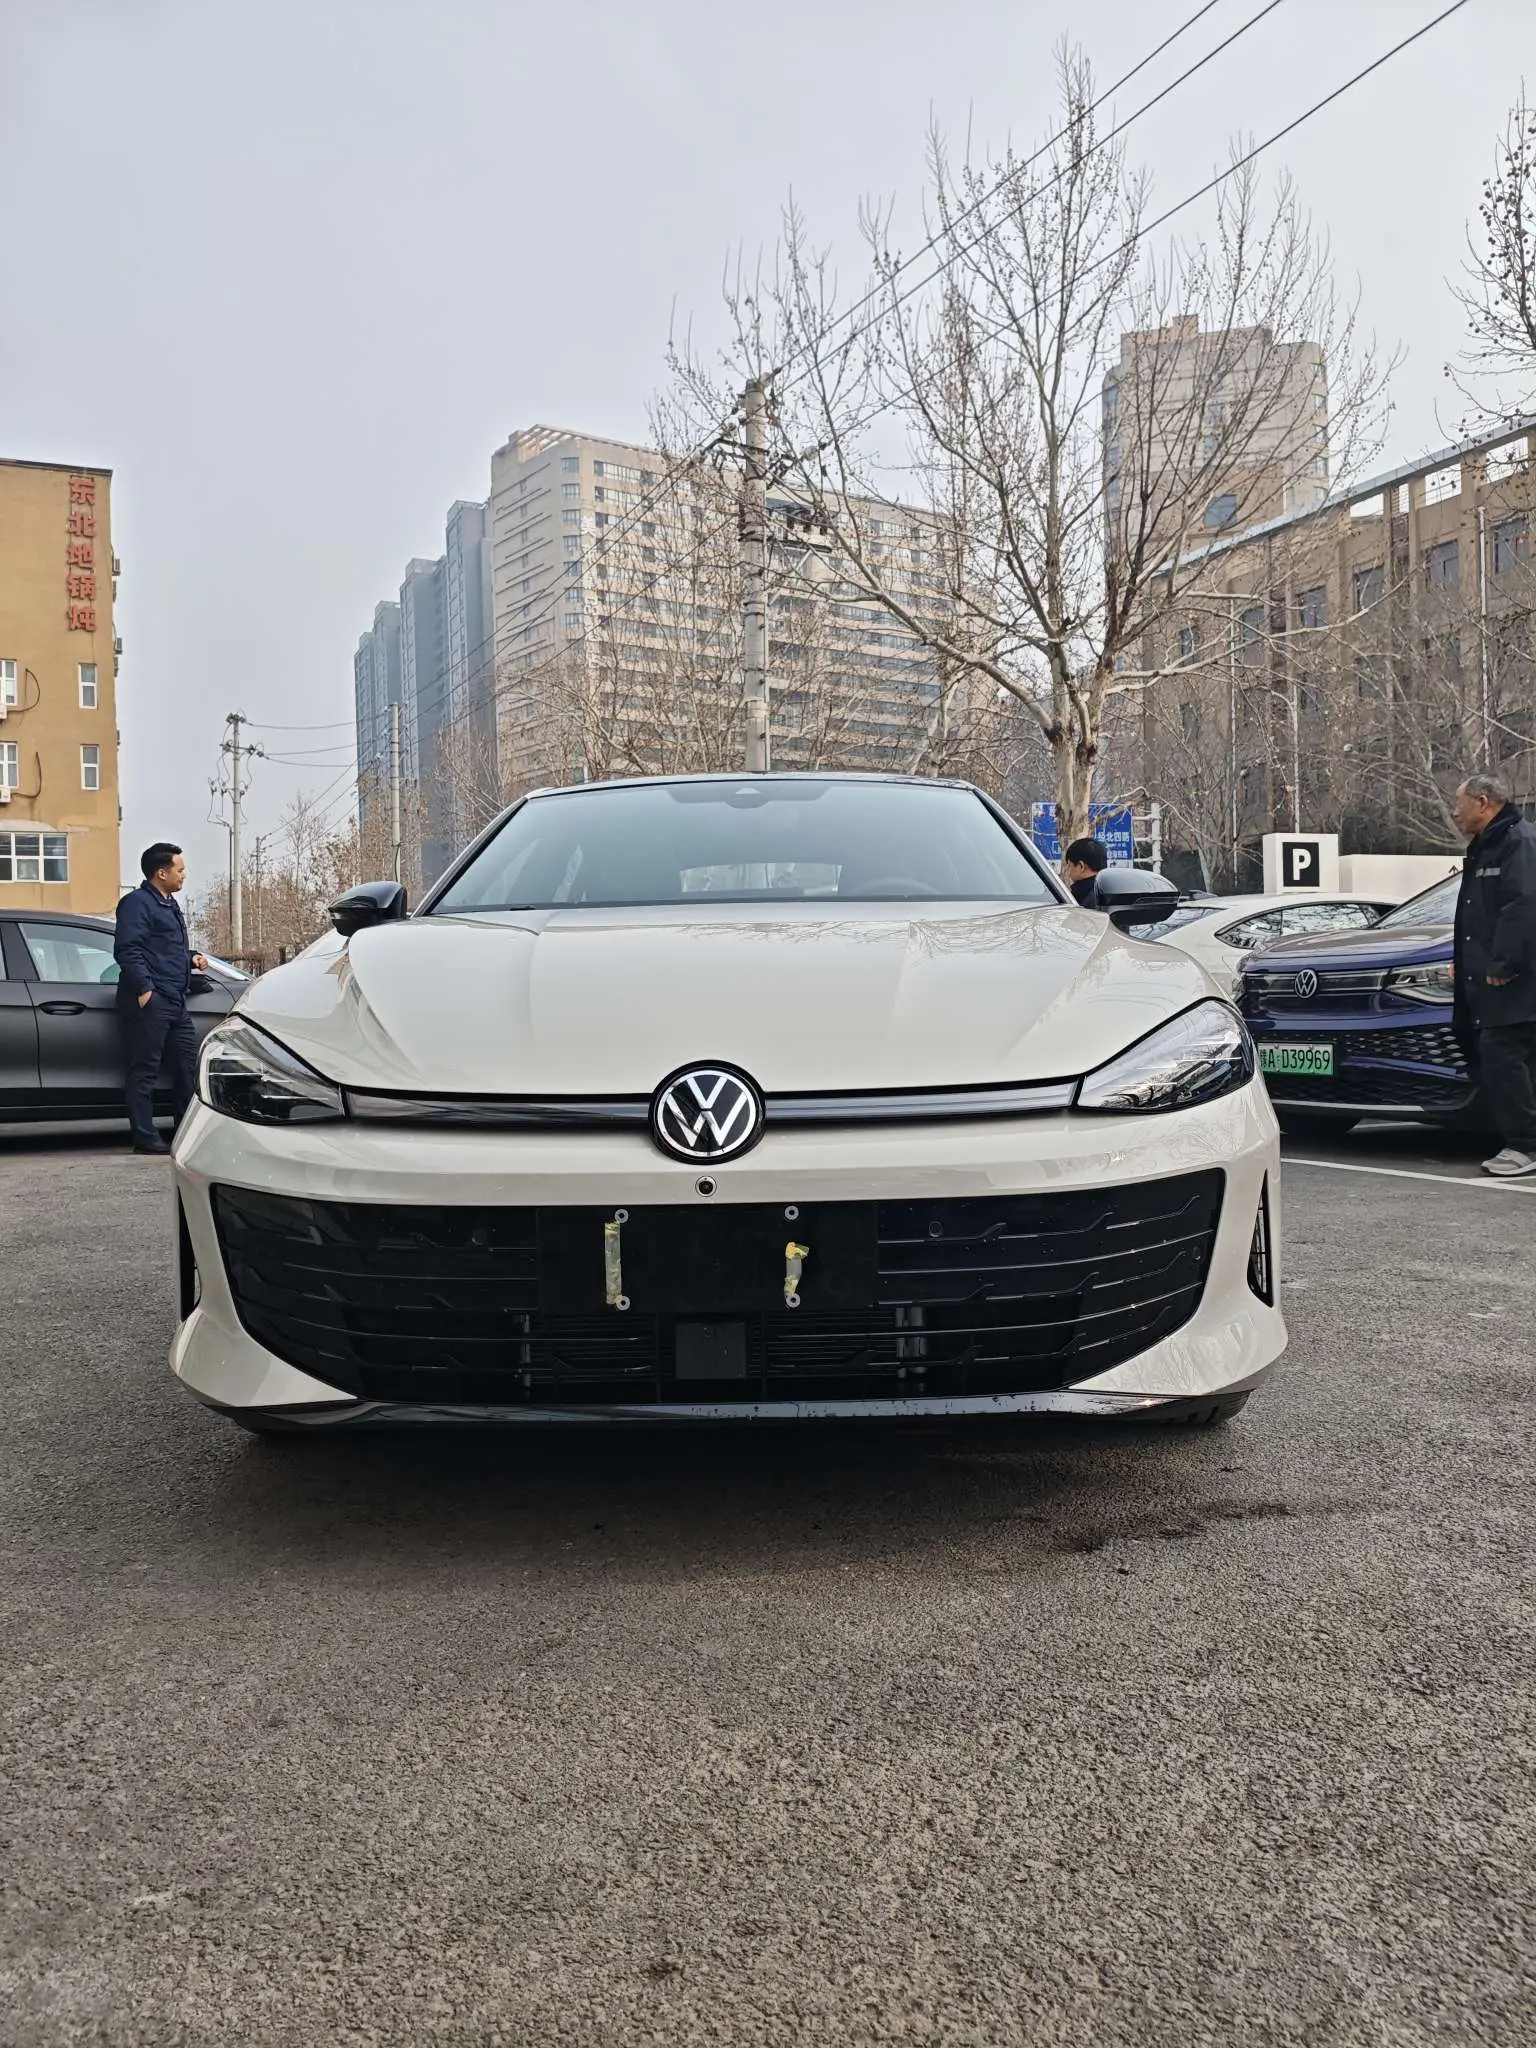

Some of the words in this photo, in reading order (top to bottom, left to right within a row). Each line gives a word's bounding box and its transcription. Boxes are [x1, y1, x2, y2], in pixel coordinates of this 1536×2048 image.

[67, 475, 96, 632] 东北地锅炖
[1292, 848, 1312, 881] P
[660, 1073, 752, 1151] VW
